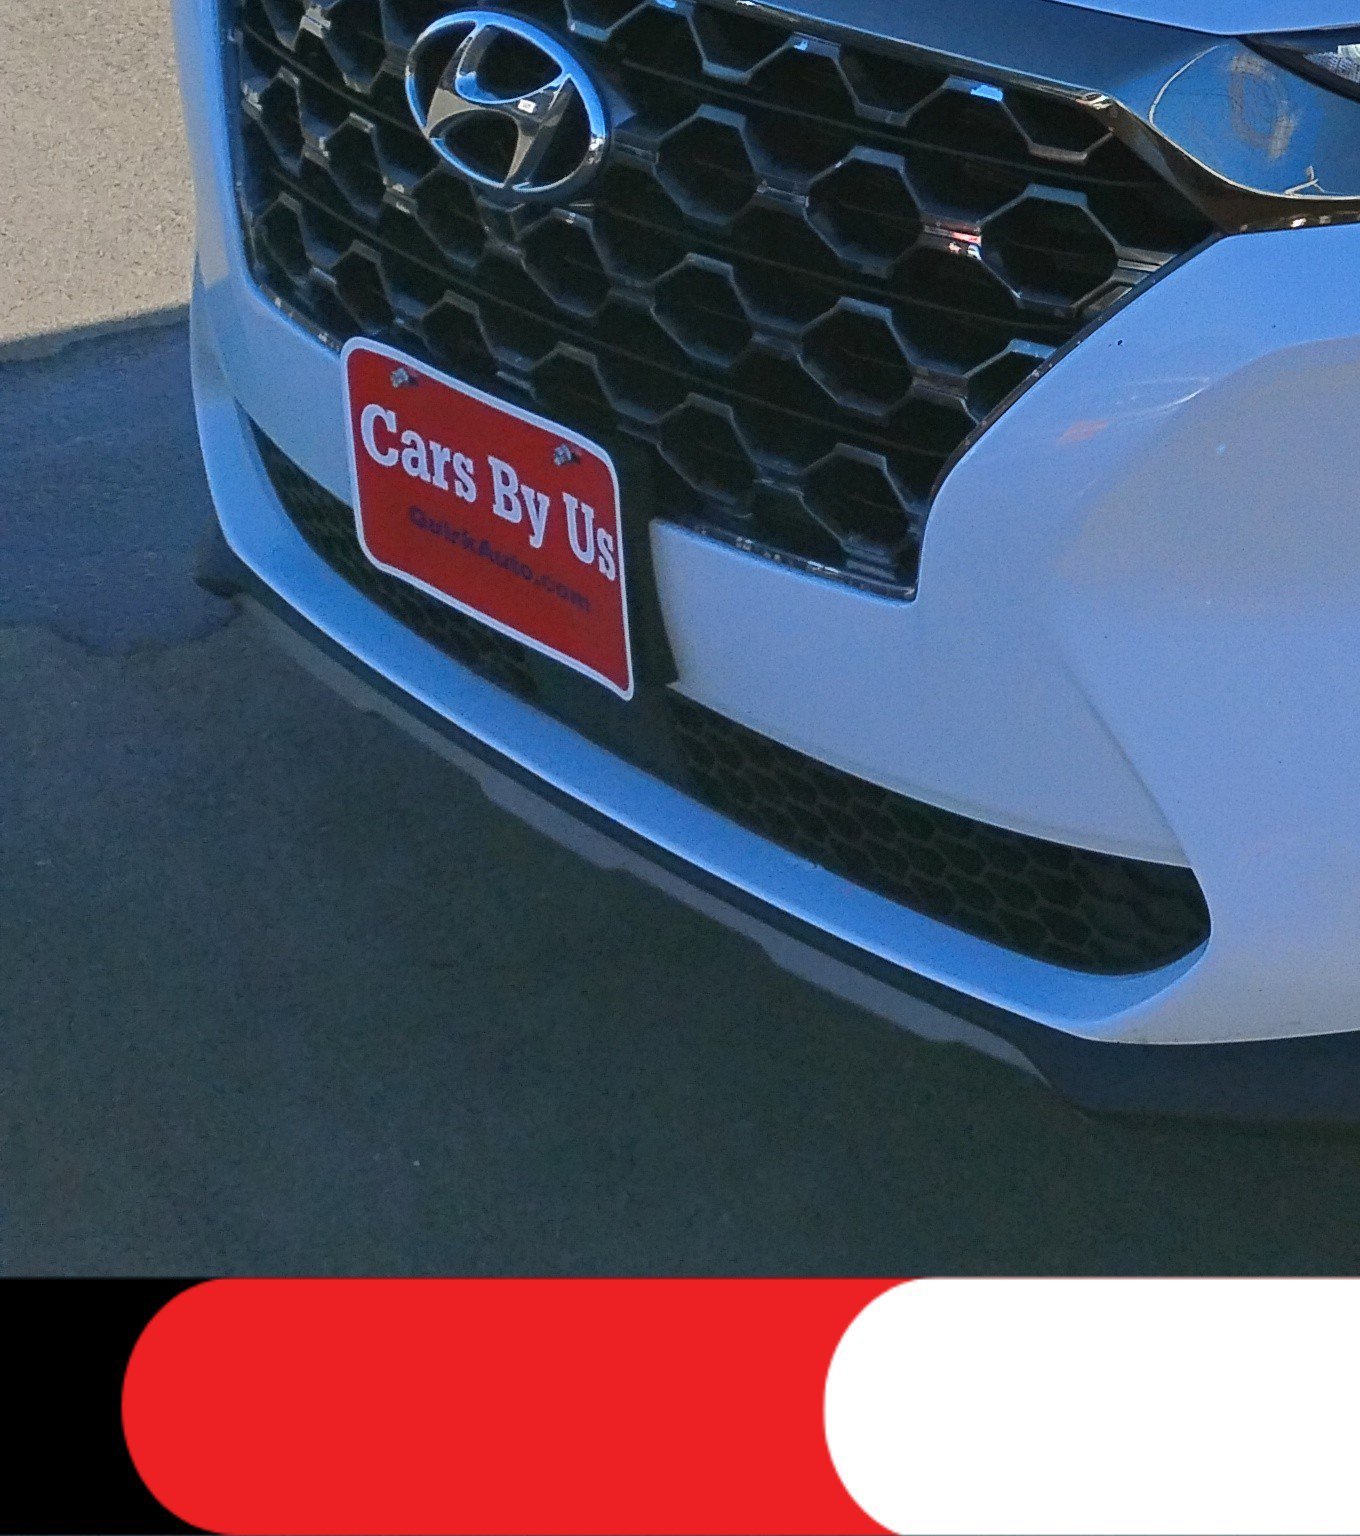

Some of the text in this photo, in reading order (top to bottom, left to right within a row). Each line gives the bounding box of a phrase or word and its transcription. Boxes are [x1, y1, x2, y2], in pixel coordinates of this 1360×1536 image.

[360, 403, 616, 581] Cars By Us
[407, 506, 591, 612] QuirkAuto.com
